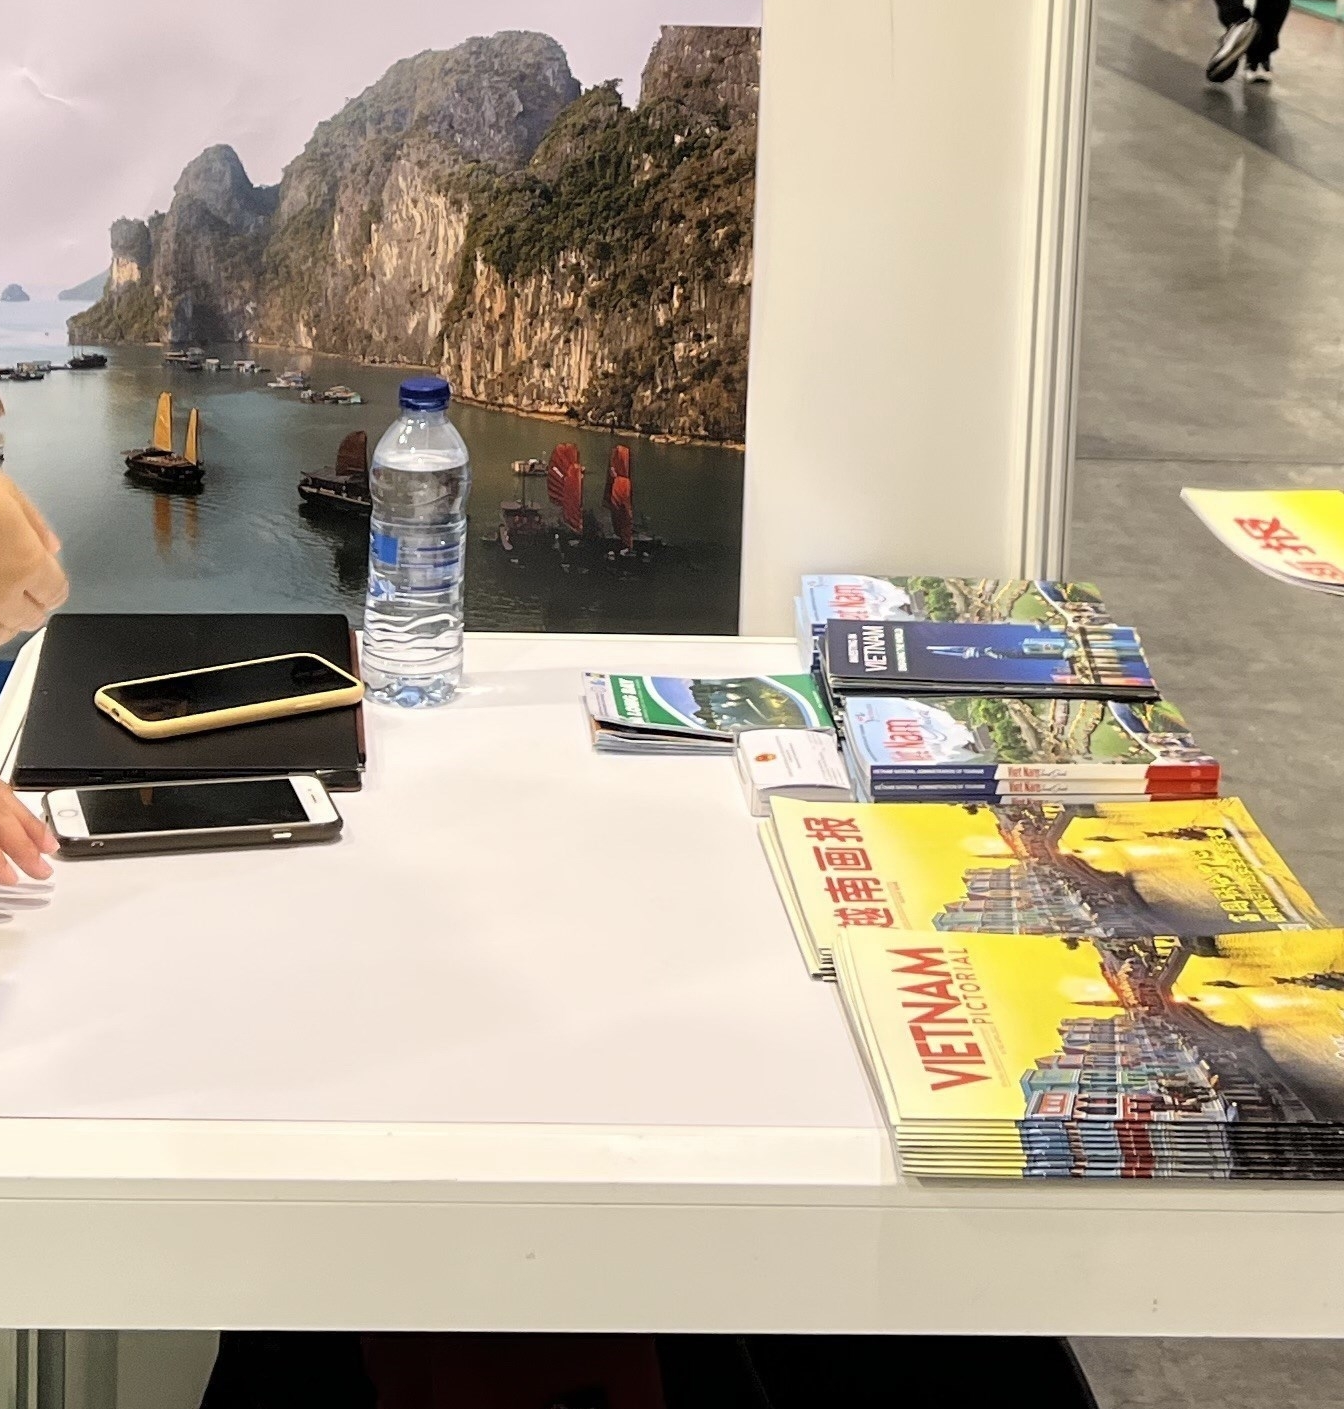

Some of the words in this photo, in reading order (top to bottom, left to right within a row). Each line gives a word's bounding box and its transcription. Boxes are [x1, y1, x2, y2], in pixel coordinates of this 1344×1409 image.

[862, 625, 887, 673] VIETNAM
[884, 719, 926, 750] Nam
[803, 817, 893, 928] 越南画报
[886, 947, 993, 1091] VIETNAM
[953, 947, 994, 1025] PICTORIAL
